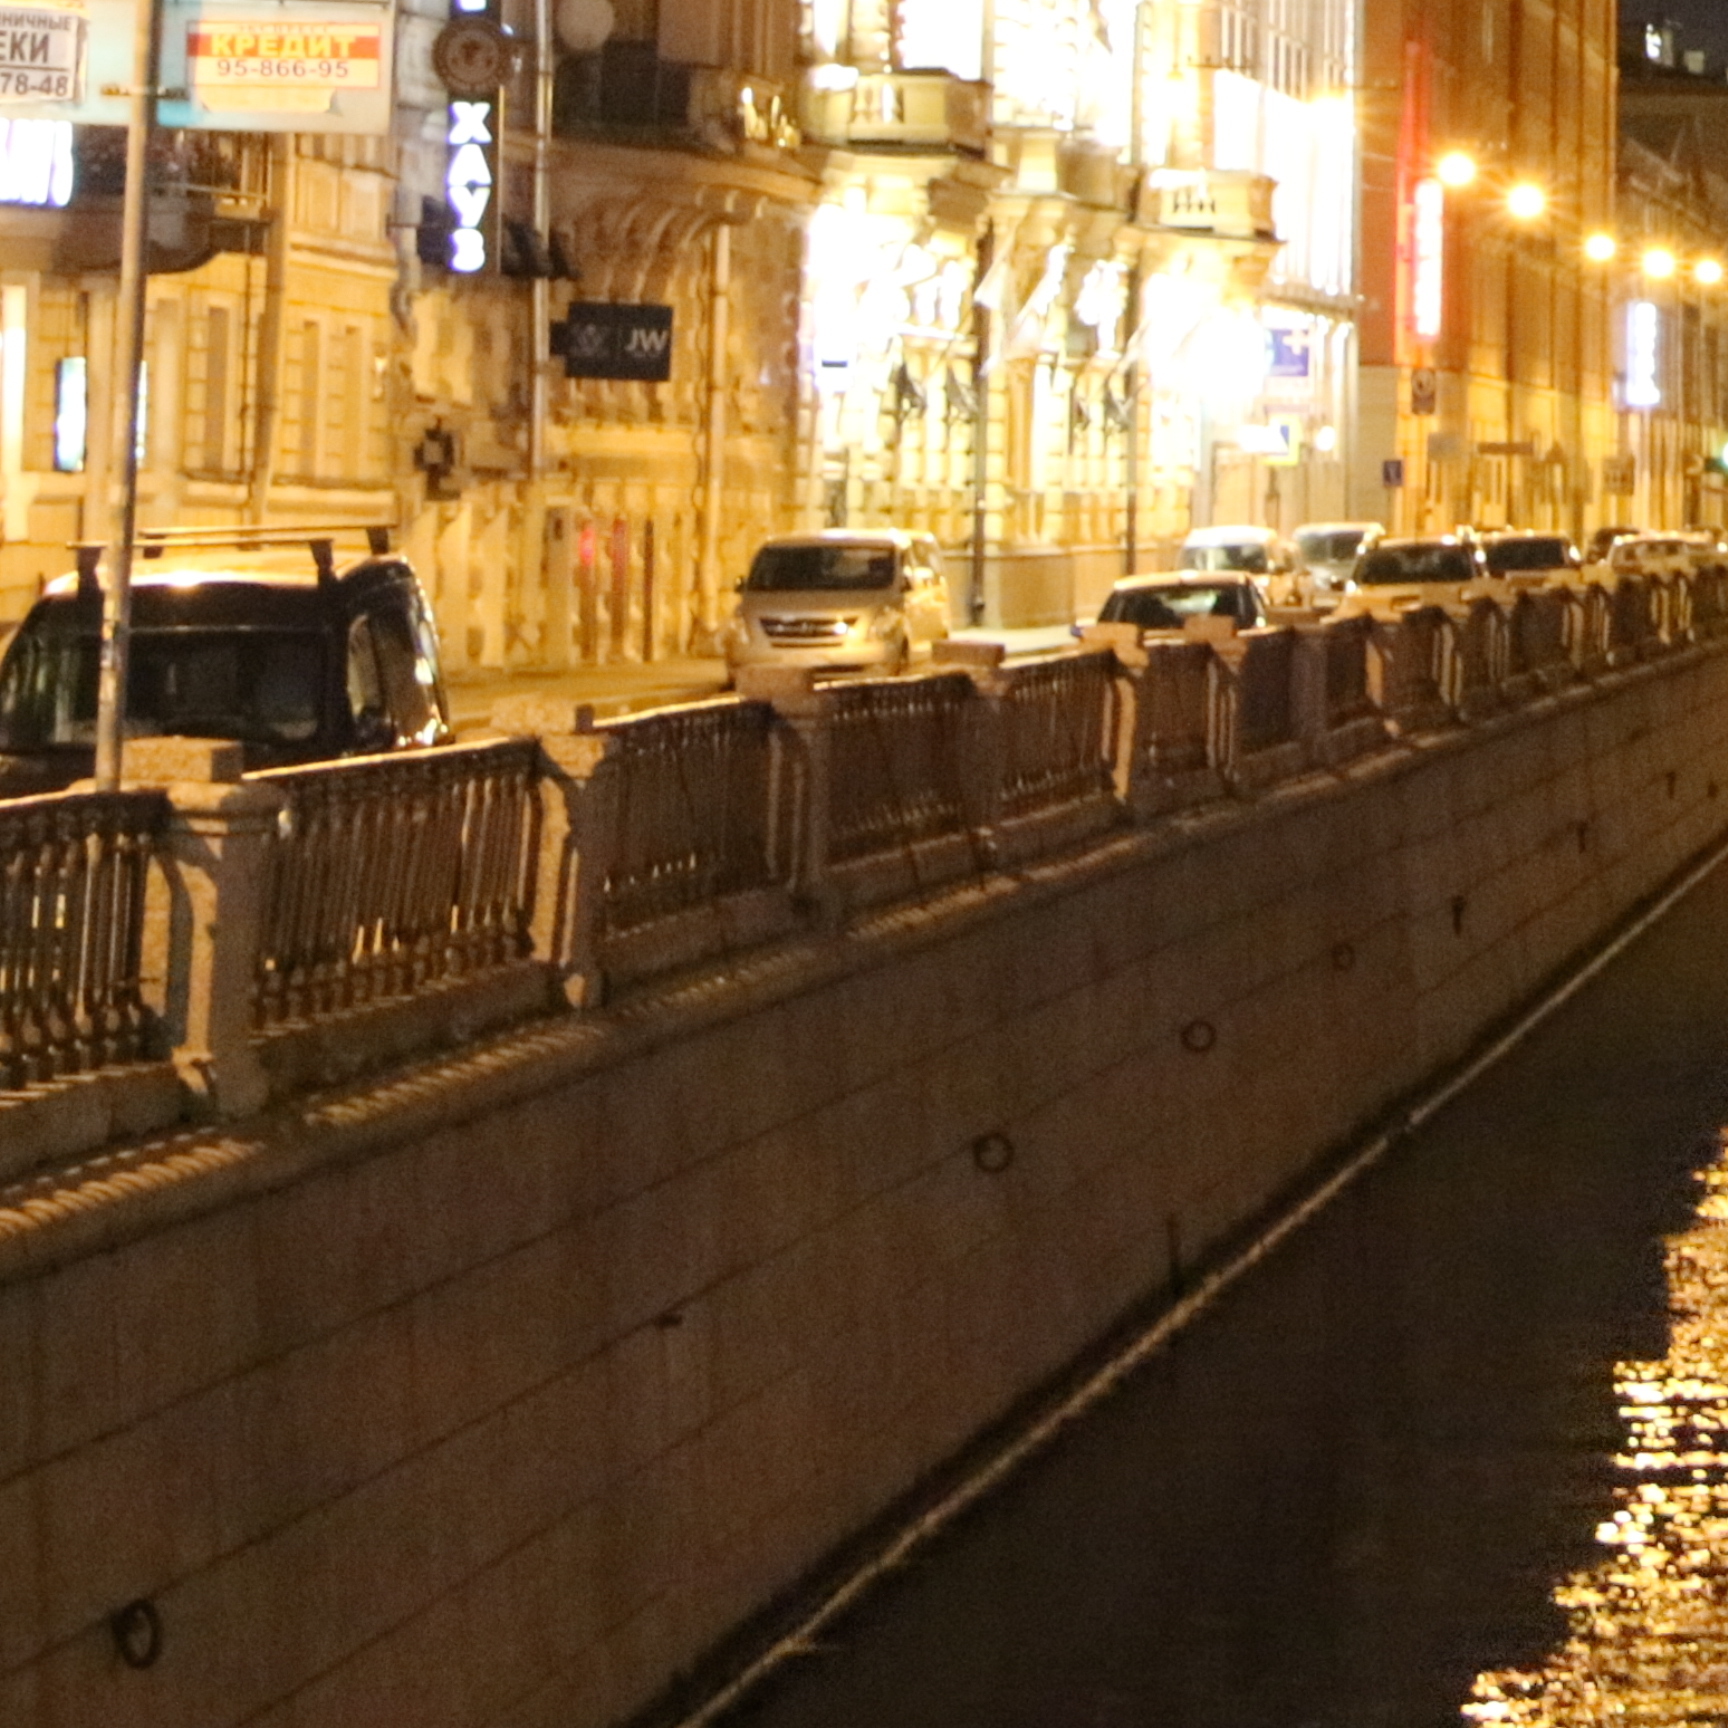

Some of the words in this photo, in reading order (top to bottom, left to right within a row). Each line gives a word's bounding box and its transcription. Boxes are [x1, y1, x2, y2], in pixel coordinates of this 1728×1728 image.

[0, 12, 72, 31] НИЧНЫЕ
[210, 33, 356, 58] КРЕДИТ
[217, 58, 349, 78] 95-866-95
[624, 328, 670, 352] JW
